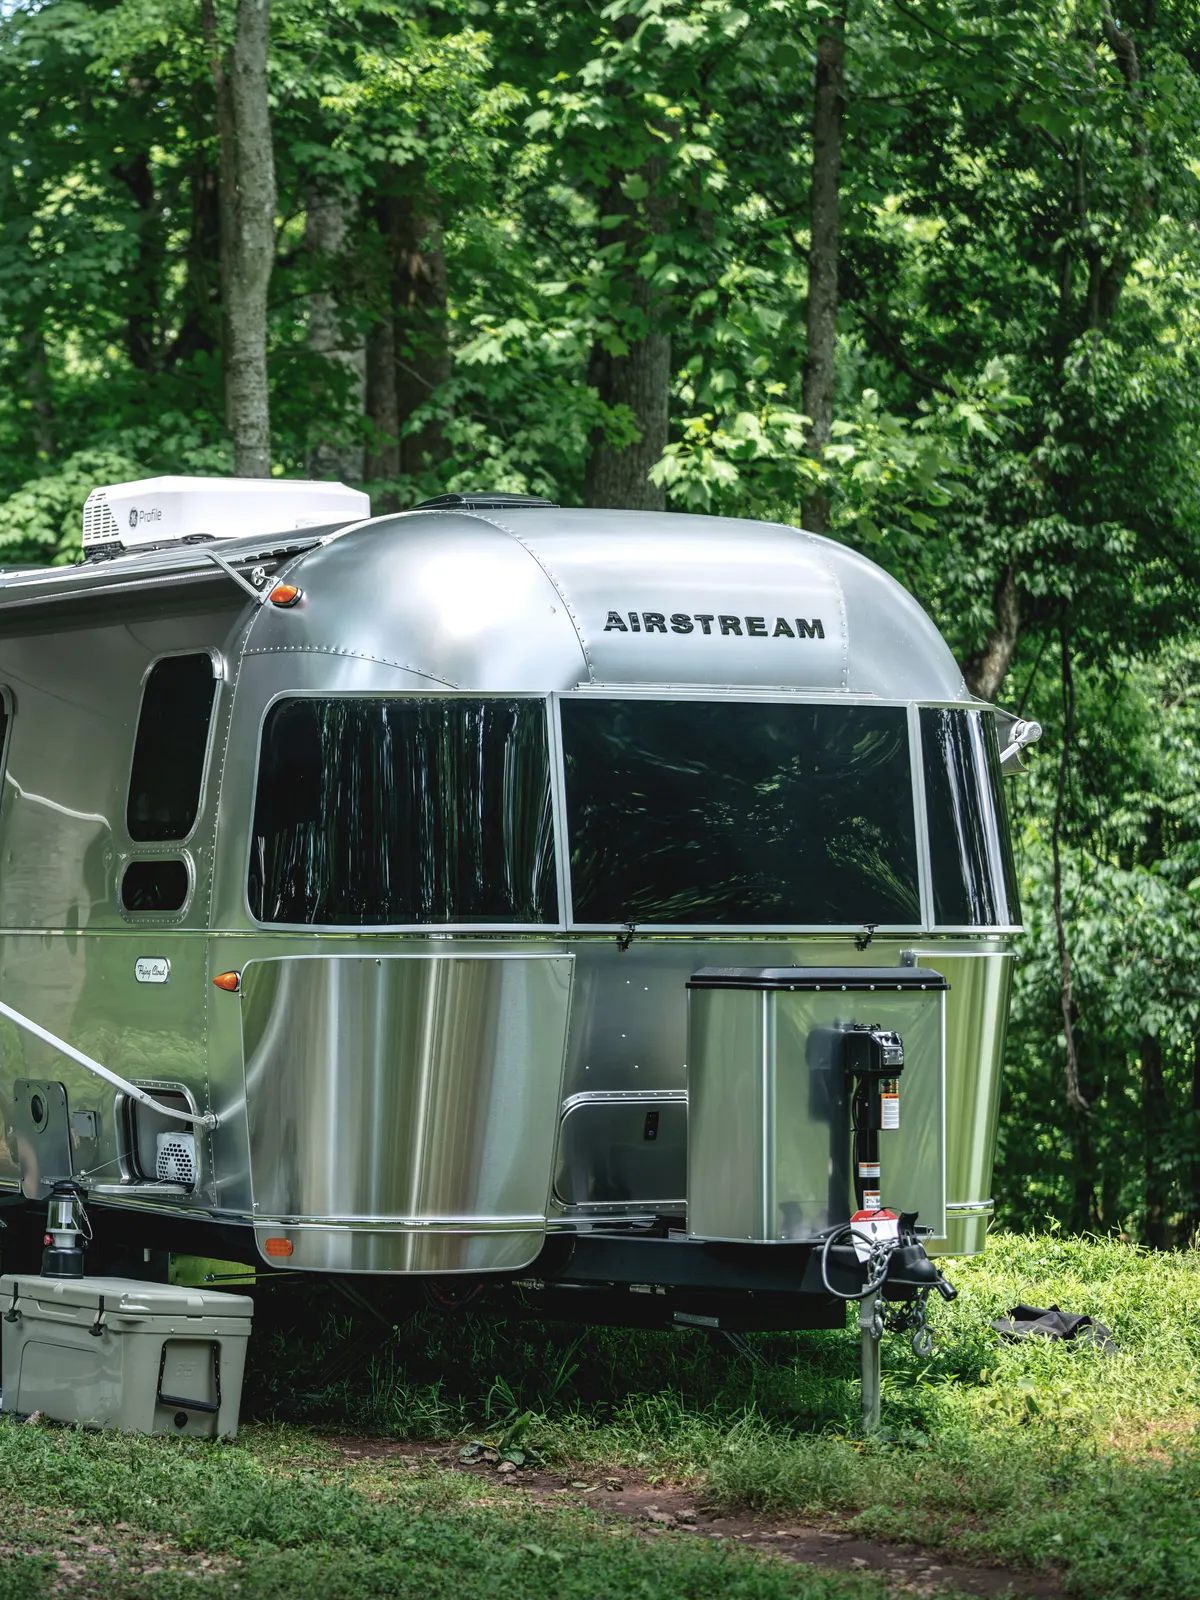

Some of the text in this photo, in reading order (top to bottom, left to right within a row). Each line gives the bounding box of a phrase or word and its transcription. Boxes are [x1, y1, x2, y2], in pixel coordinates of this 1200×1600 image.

[139, 508, 162, 524] Profile
[603, 611, 825, 639] AIRSTREAM
[137, 964, 166, 979] Flying Cloud
